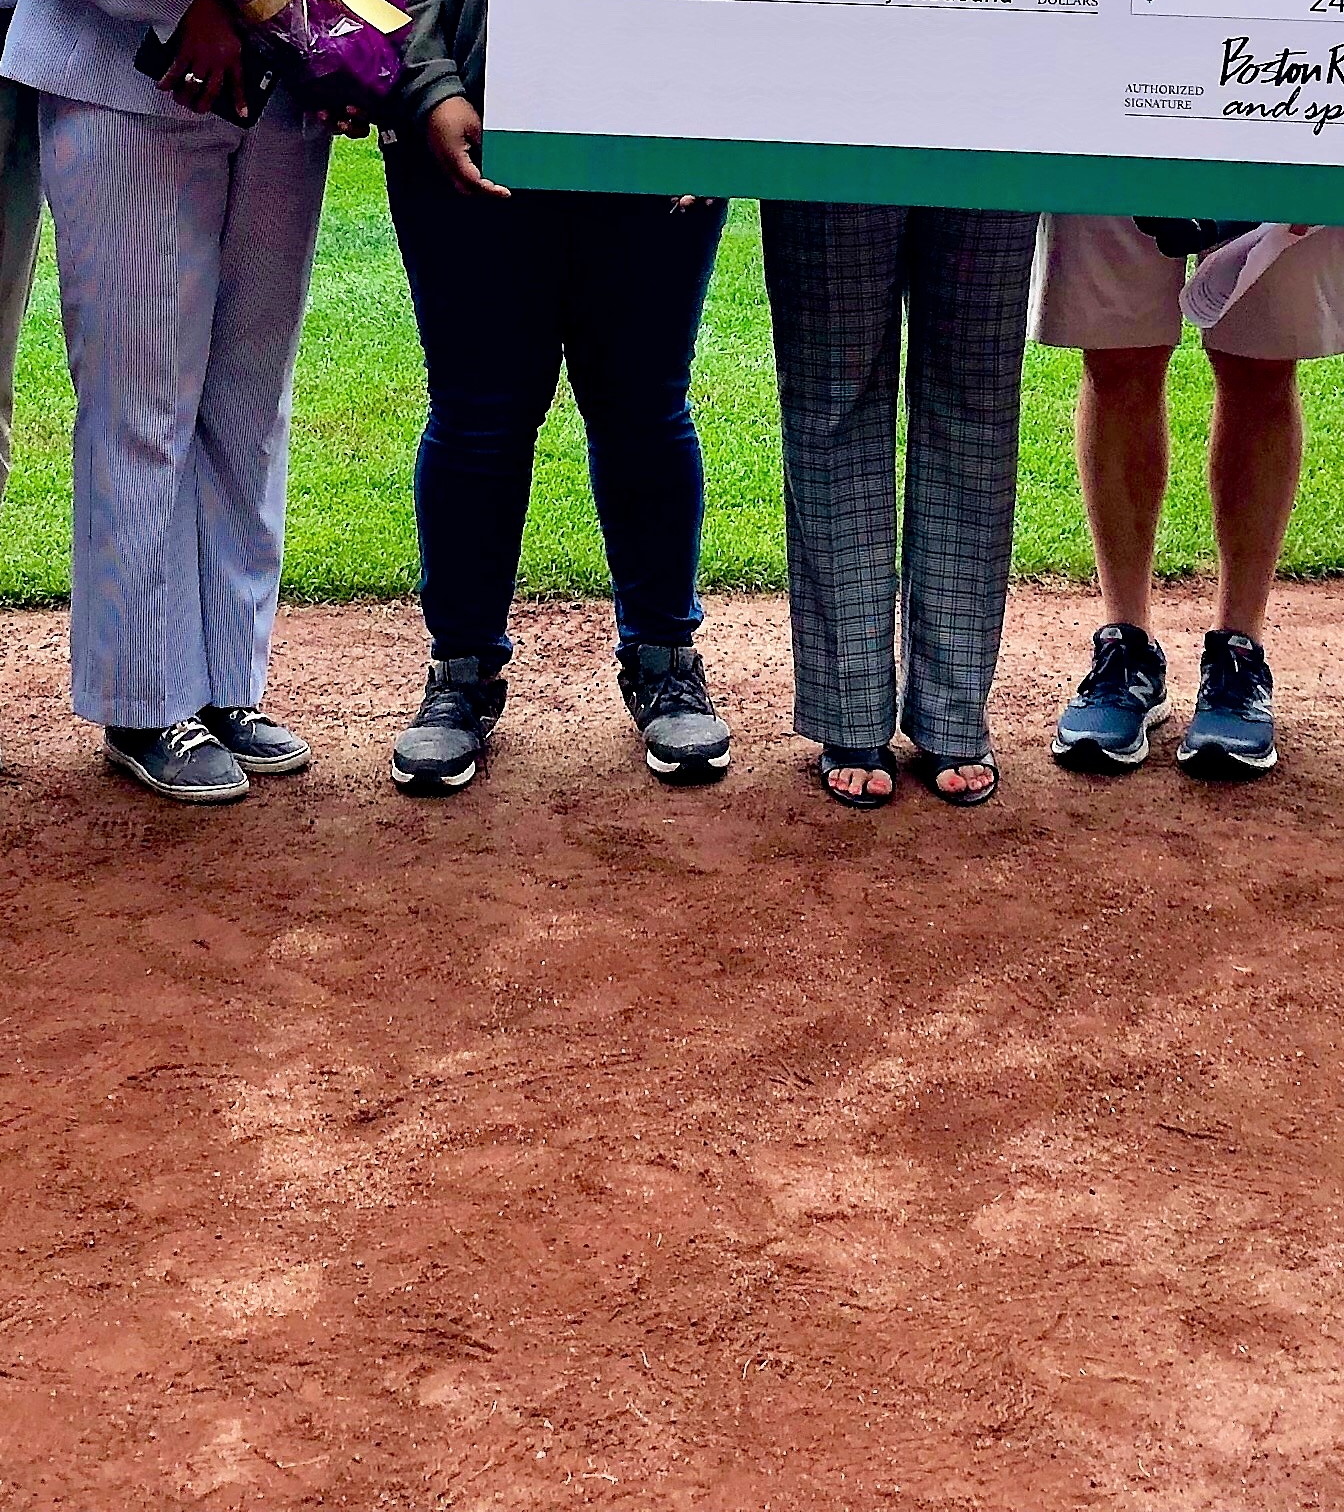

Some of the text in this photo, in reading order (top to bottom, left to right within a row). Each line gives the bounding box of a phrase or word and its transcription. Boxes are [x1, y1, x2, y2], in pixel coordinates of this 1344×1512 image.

[1219, 36, 1322, 87] Boston
[1124, 84, 1205, 97] AUTHORIZED
[1223, 86, 1301, 117] and
[1124, 97, 1192, 110] SIGNATURE
